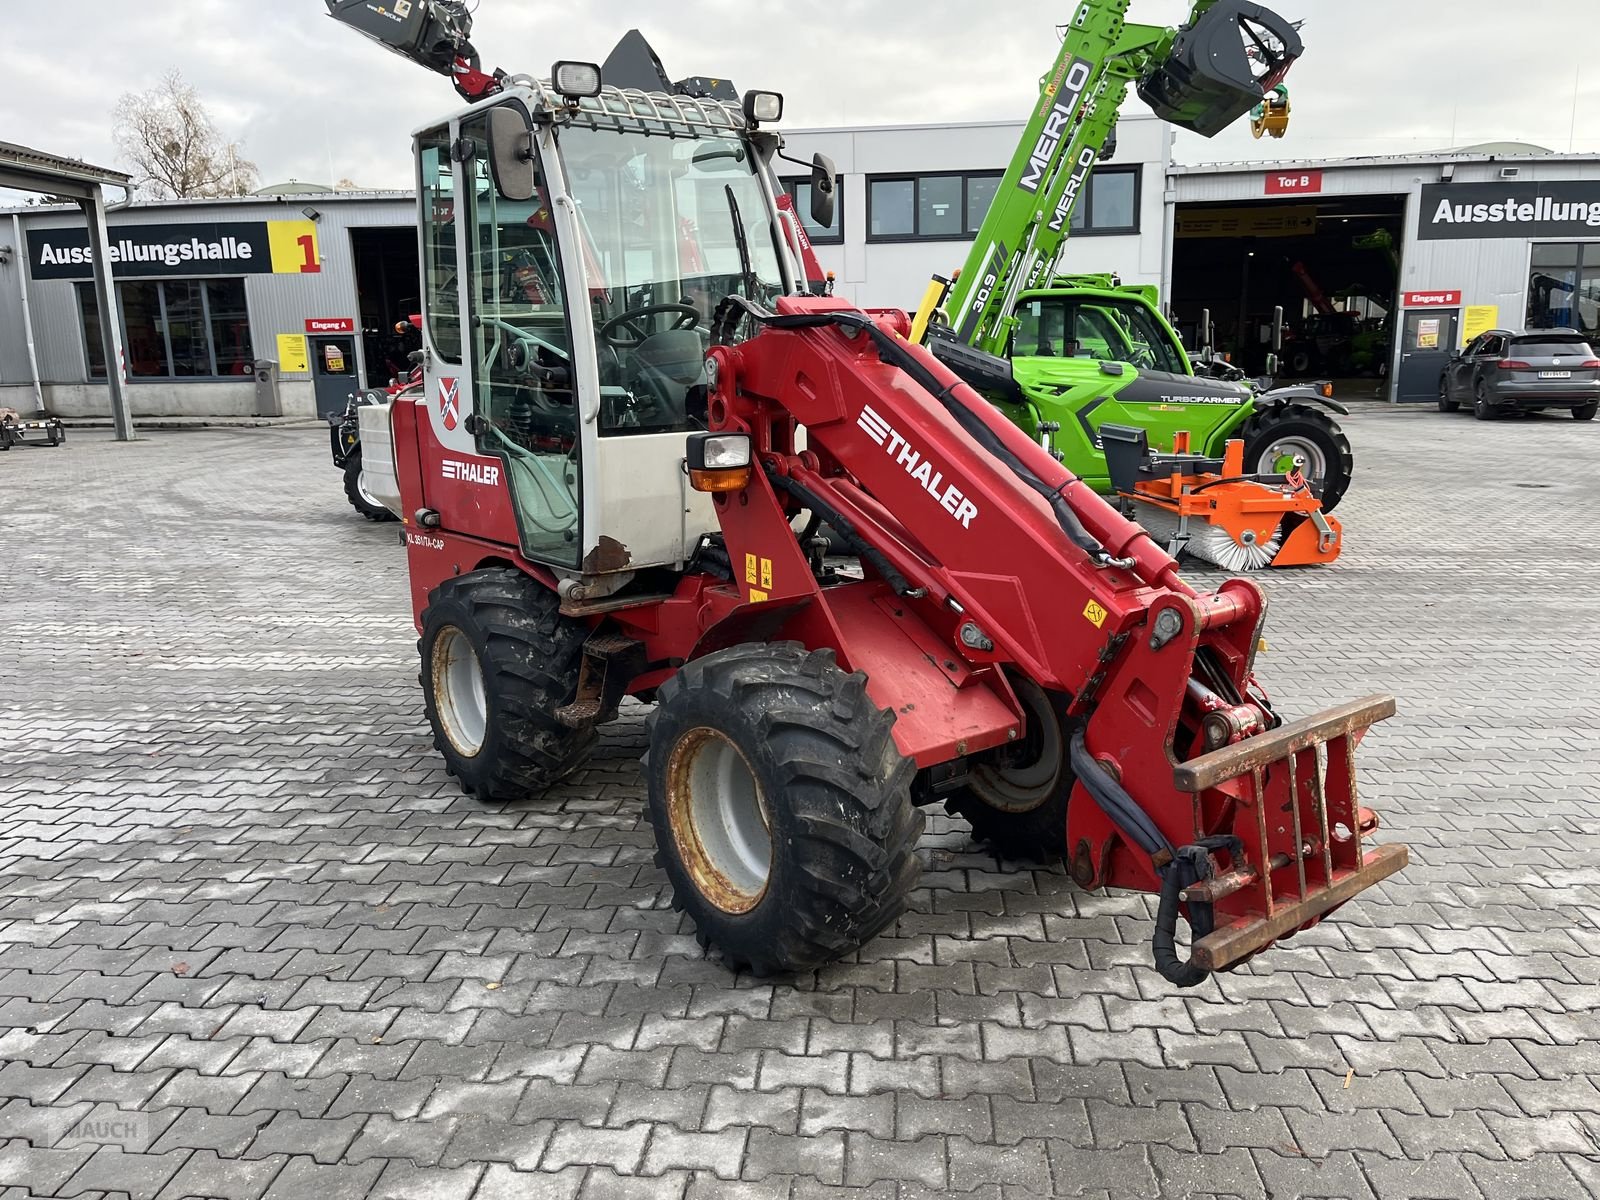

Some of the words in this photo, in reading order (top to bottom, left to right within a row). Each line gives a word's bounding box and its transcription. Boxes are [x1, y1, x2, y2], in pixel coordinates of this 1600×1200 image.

[1022, 61, 1090, 191] MERLO
[1050, 148, 1095, 231] MERLO
[1278, 177, 1298, 188] Tor
[1300, 176, 1309, 187] B
[1432, 196, 1600, 227] Ausstellung
[40, 237, 253, 266] Aussellungshalle
[297, 235, 321, 273] 1
[1028, 260, 1044, 287] 44.9
[973, 273, 996, 313] 30.9
[1411, 295, 1445, 303] Eingang
[312, 322, 340, 330] Eingang
[1160, 396, 1241, 404] TURBOFARMER
